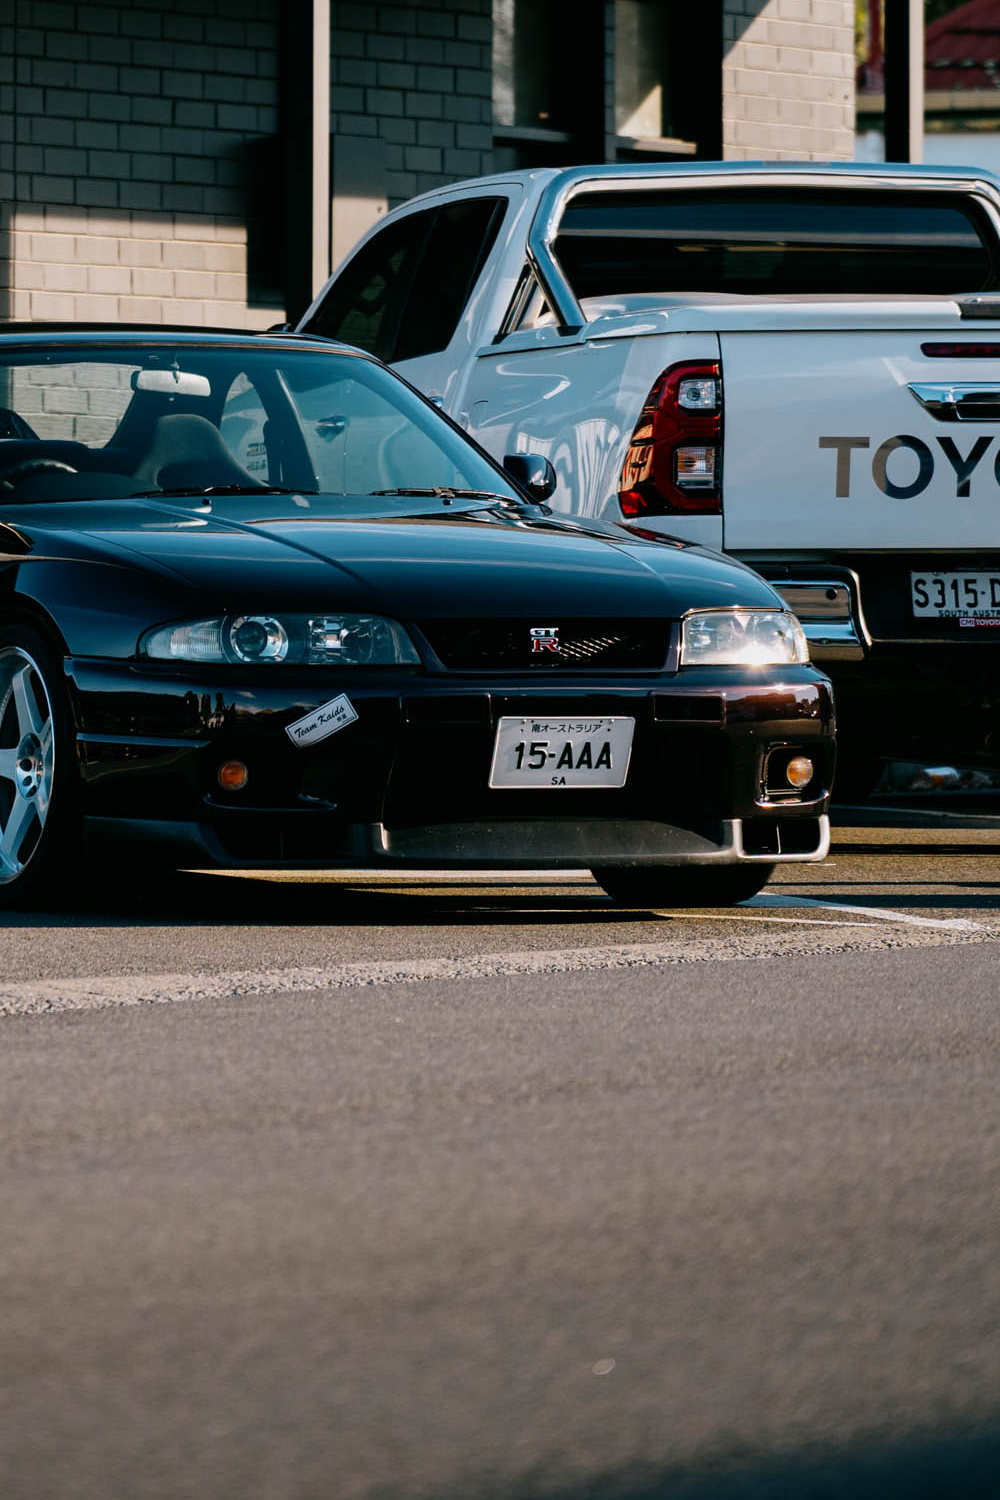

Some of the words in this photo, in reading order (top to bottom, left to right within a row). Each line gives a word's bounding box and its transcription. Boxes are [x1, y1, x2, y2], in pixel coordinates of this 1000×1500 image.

[818, 435, 1000, 500] TOY
[294, 723, 318, 739] Team
[531, 724, 602, 733] 南オーストラリア
[514, 741, 612, 770] 15-AAA
[551, 776, 567, 786] SA
